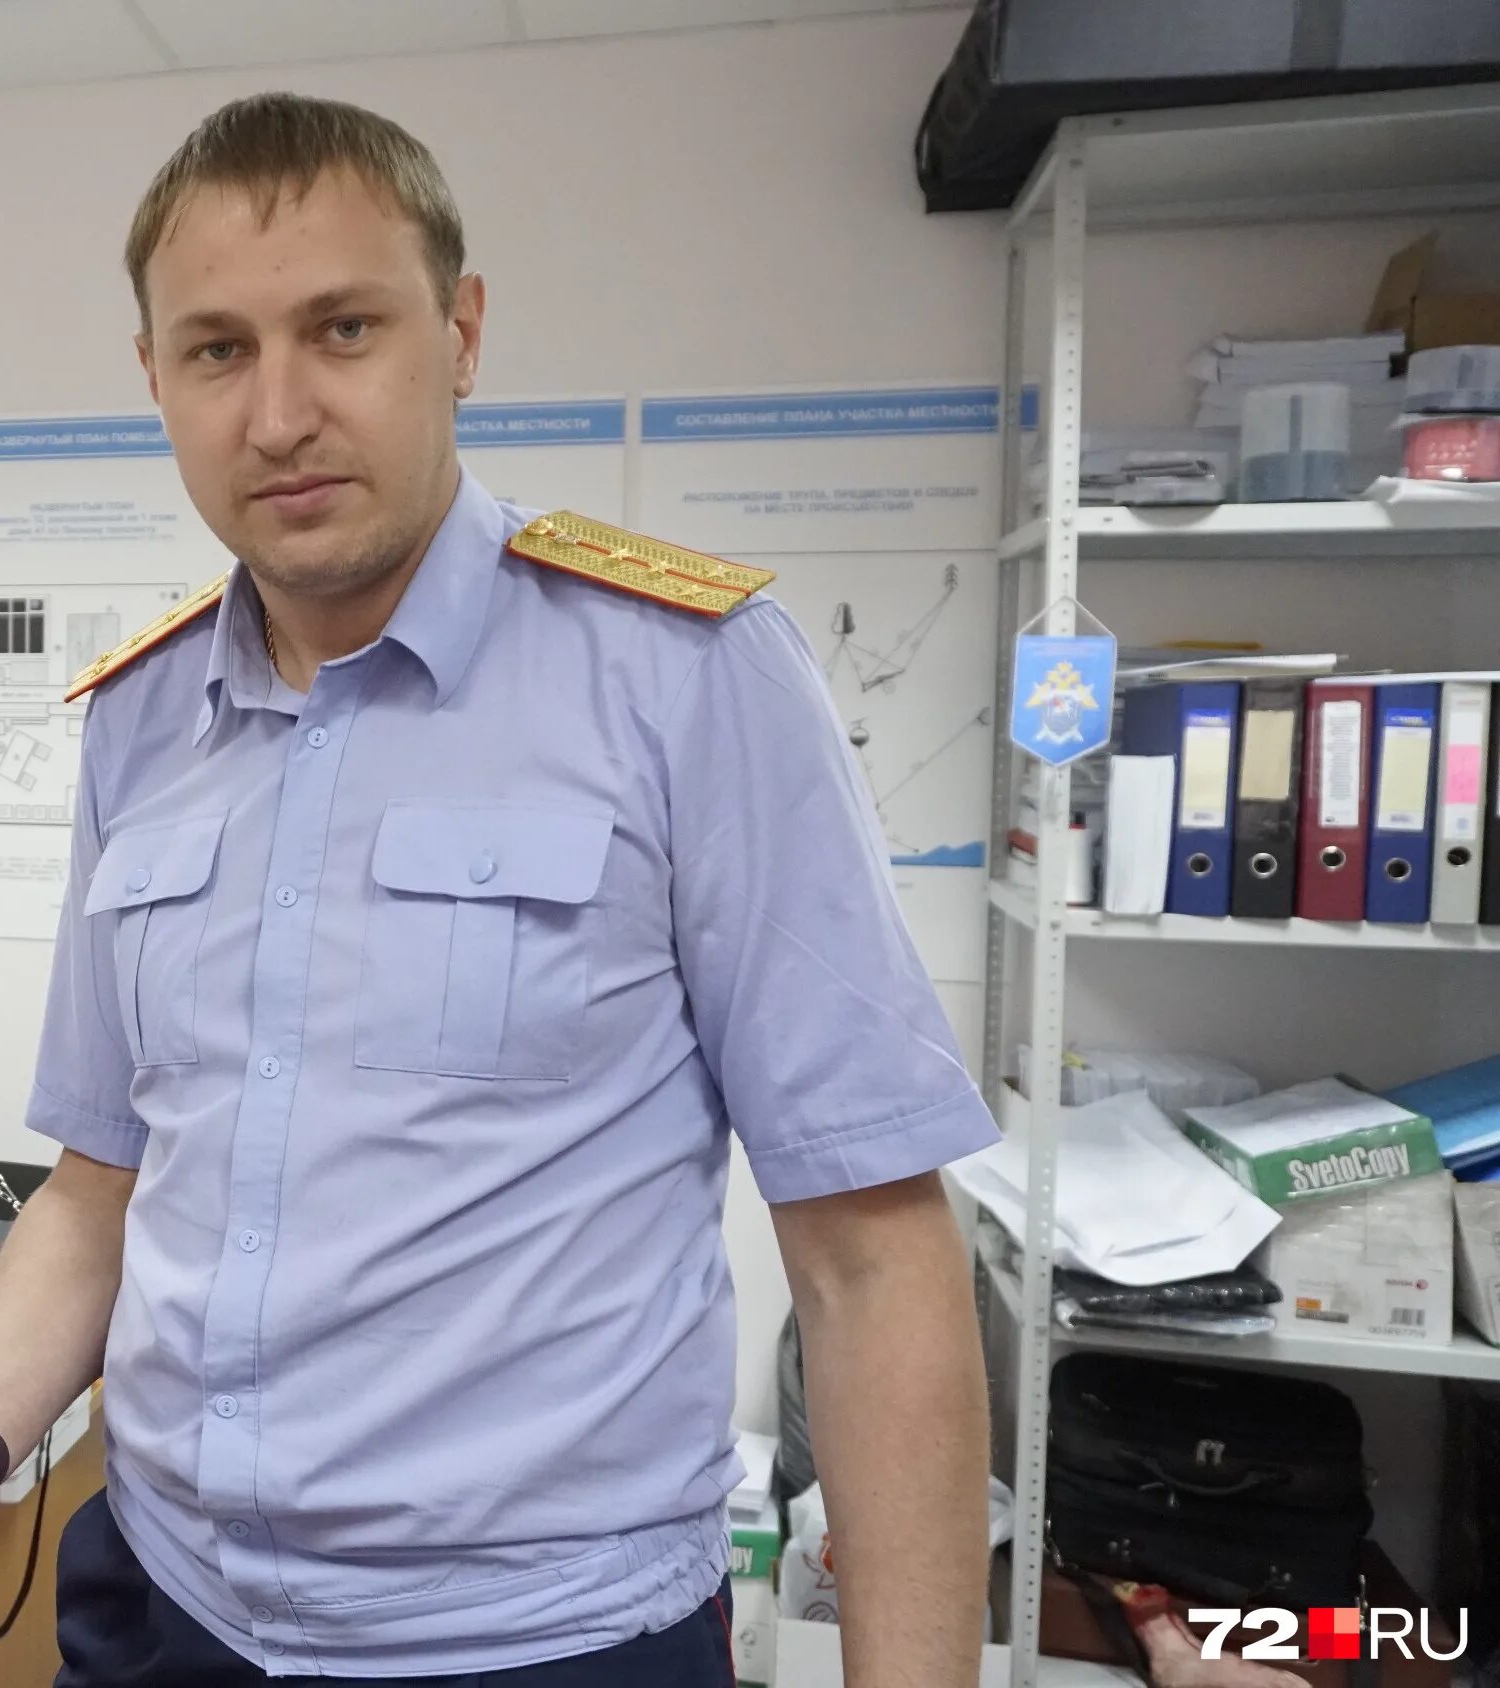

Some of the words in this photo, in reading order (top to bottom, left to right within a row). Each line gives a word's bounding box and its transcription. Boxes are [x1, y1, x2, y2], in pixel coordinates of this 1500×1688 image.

[507, 416, 591, 431] МЕСТНОСТИ
[676, 412, 779, 427] СОСТАВЛЕНИЕ
[783, 409, 834, 423] ПЛАНА
[837, 407, 905, 421] УЧАСТКА
[75, 432, 109, 445] ПЛАН
[1287, 1143, 1411, 1191] SvetoCopy
